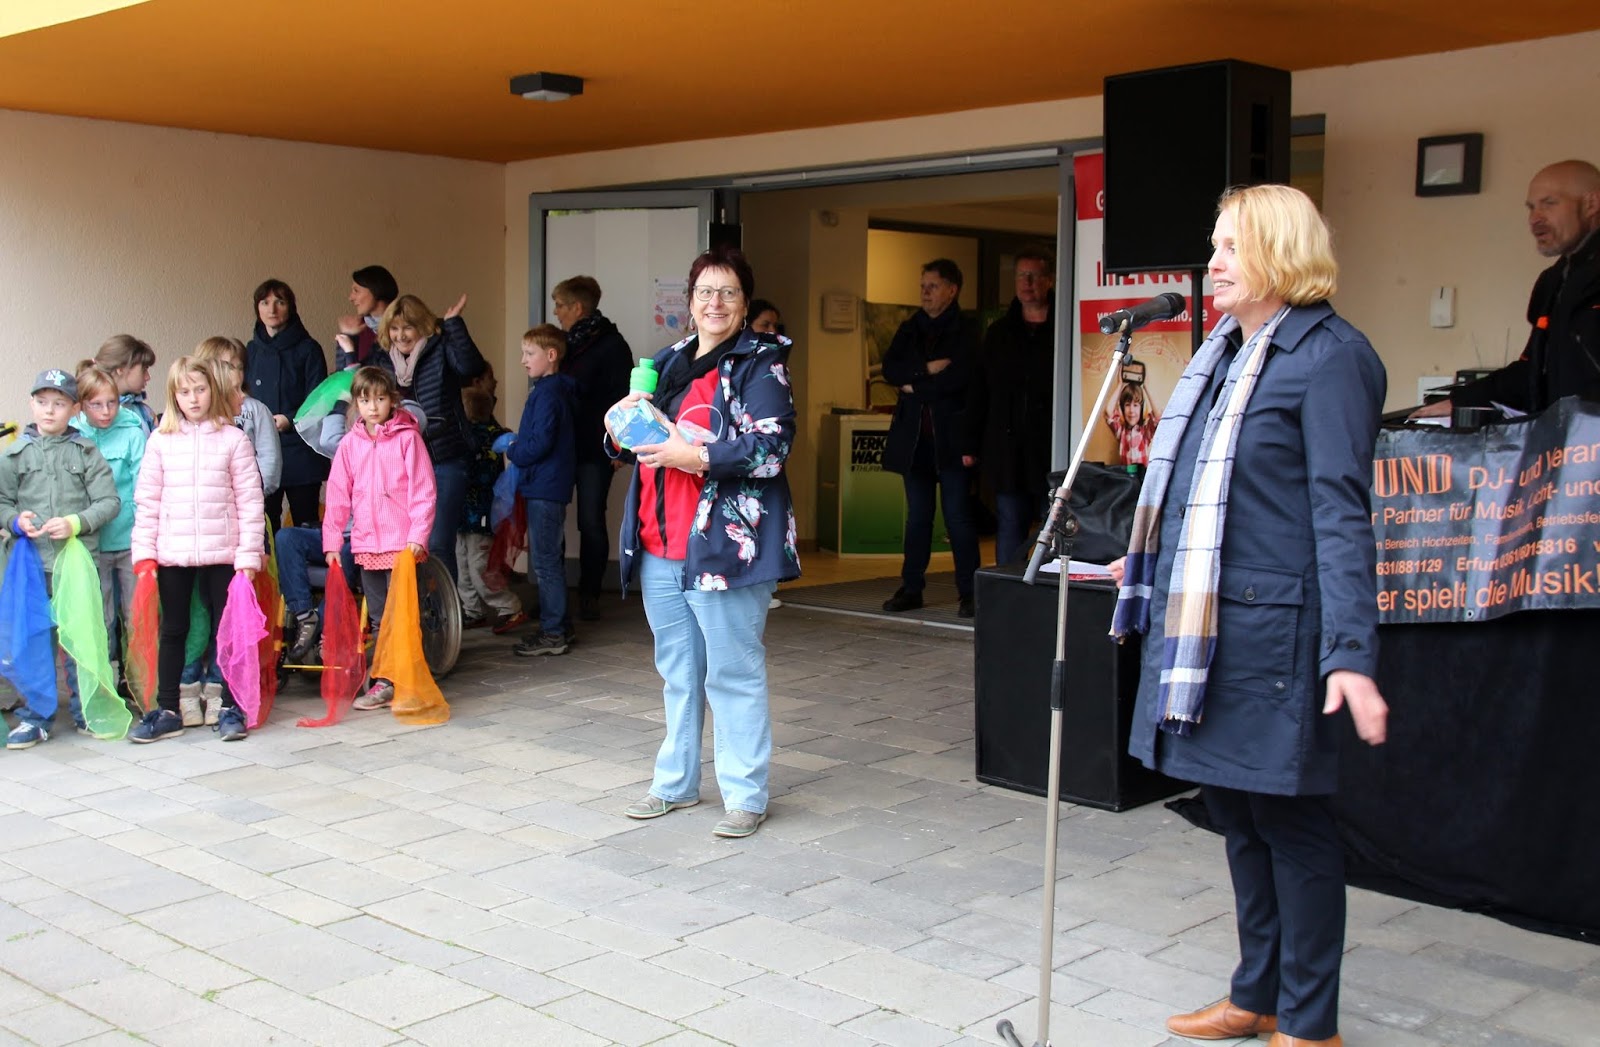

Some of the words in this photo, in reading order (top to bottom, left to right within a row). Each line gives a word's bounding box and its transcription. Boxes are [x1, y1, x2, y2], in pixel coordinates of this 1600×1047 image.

[1373, 454, 1453, 497] UND
[1469, 465, 1514, 490] DJ-
[1519, 454, 1543, 487] und
[1384, 506, 1444, 525] Partner
[1449, 503, 1472, 520] für
[1385, 537, 1419, 550] Bereich
[1376, 558, 1442, 576] 631/881129
[1456, 556, 1499, 571] Erfurt
[1377, 589, 1398, 611] er
[1404, 580, 1466, 616] spielt
[1475, 579, 1507, 608] die
